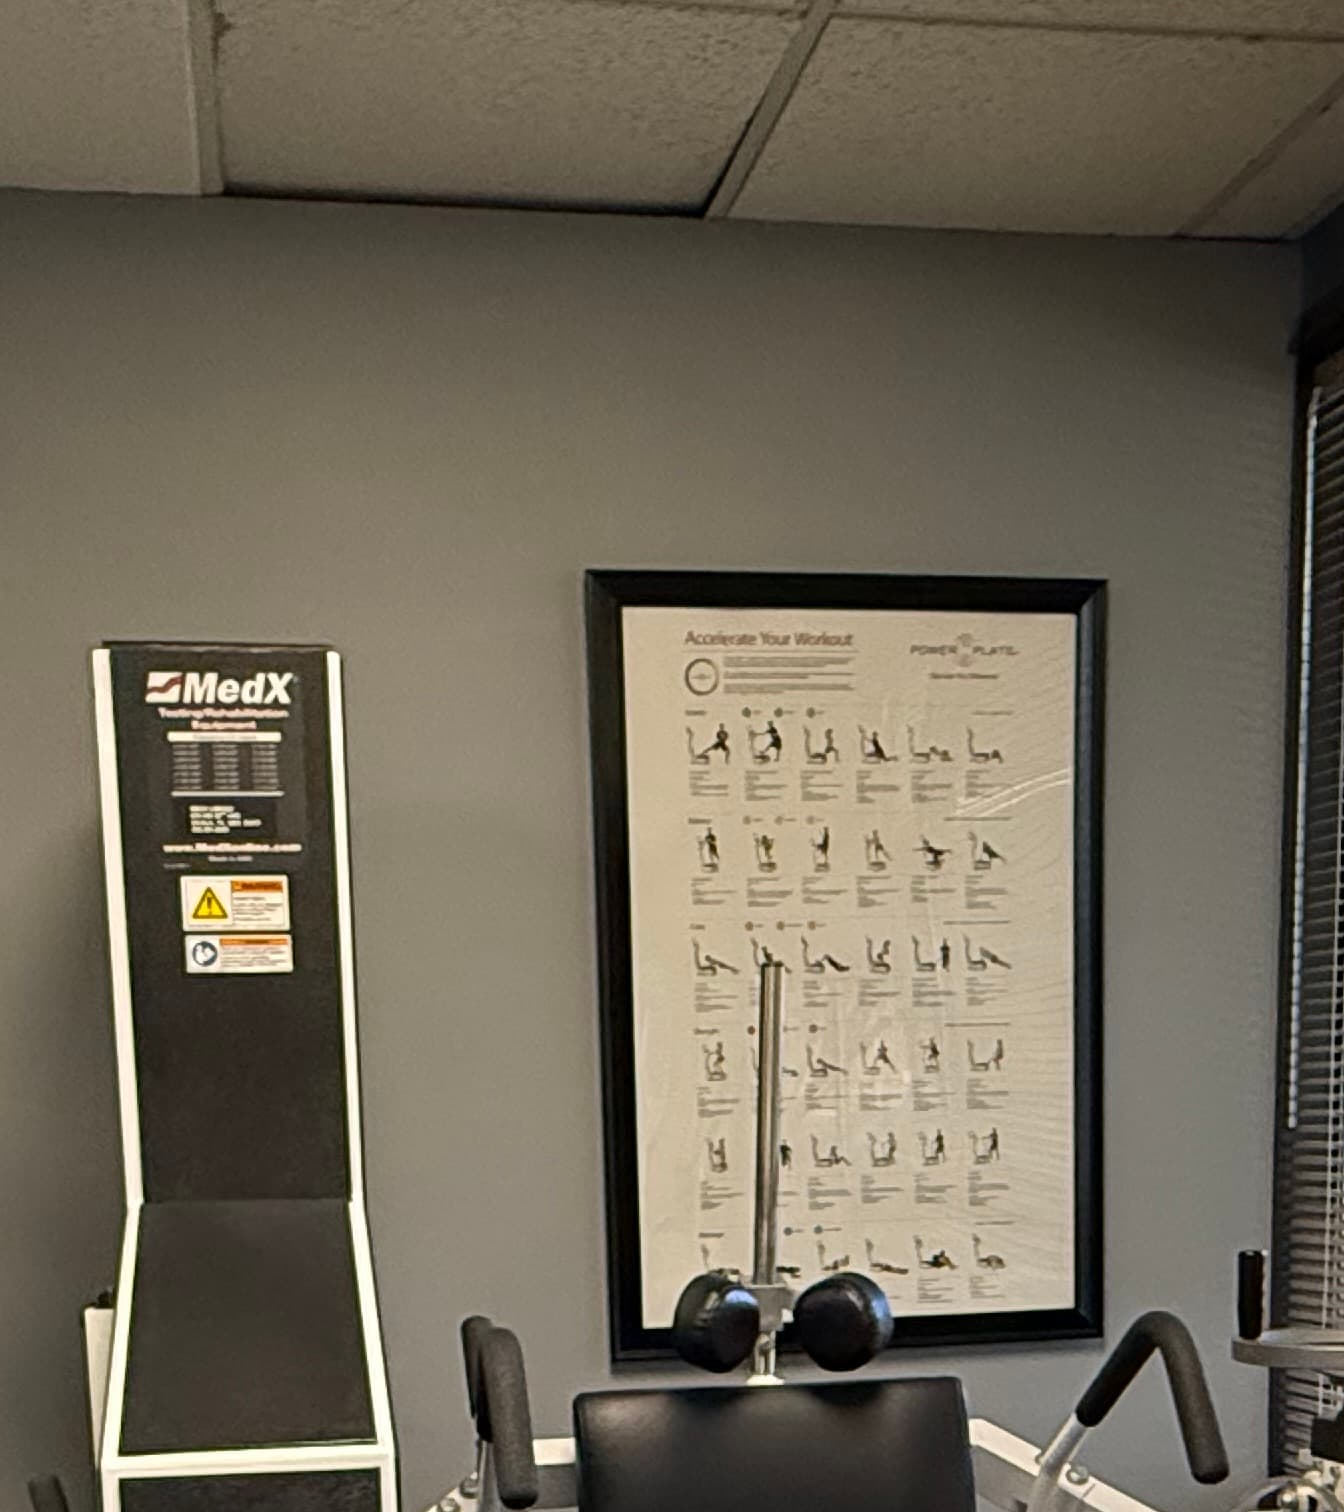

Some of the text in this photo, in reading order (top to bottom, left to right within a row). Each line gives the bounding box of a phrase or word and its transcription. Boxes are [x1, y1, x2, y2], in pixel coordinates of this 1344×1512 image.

[685, 630, 854, 646] Accelerate Your Workout
[910, 644, 957, 656] POWER
[182, 672, 293, 704] MedX
